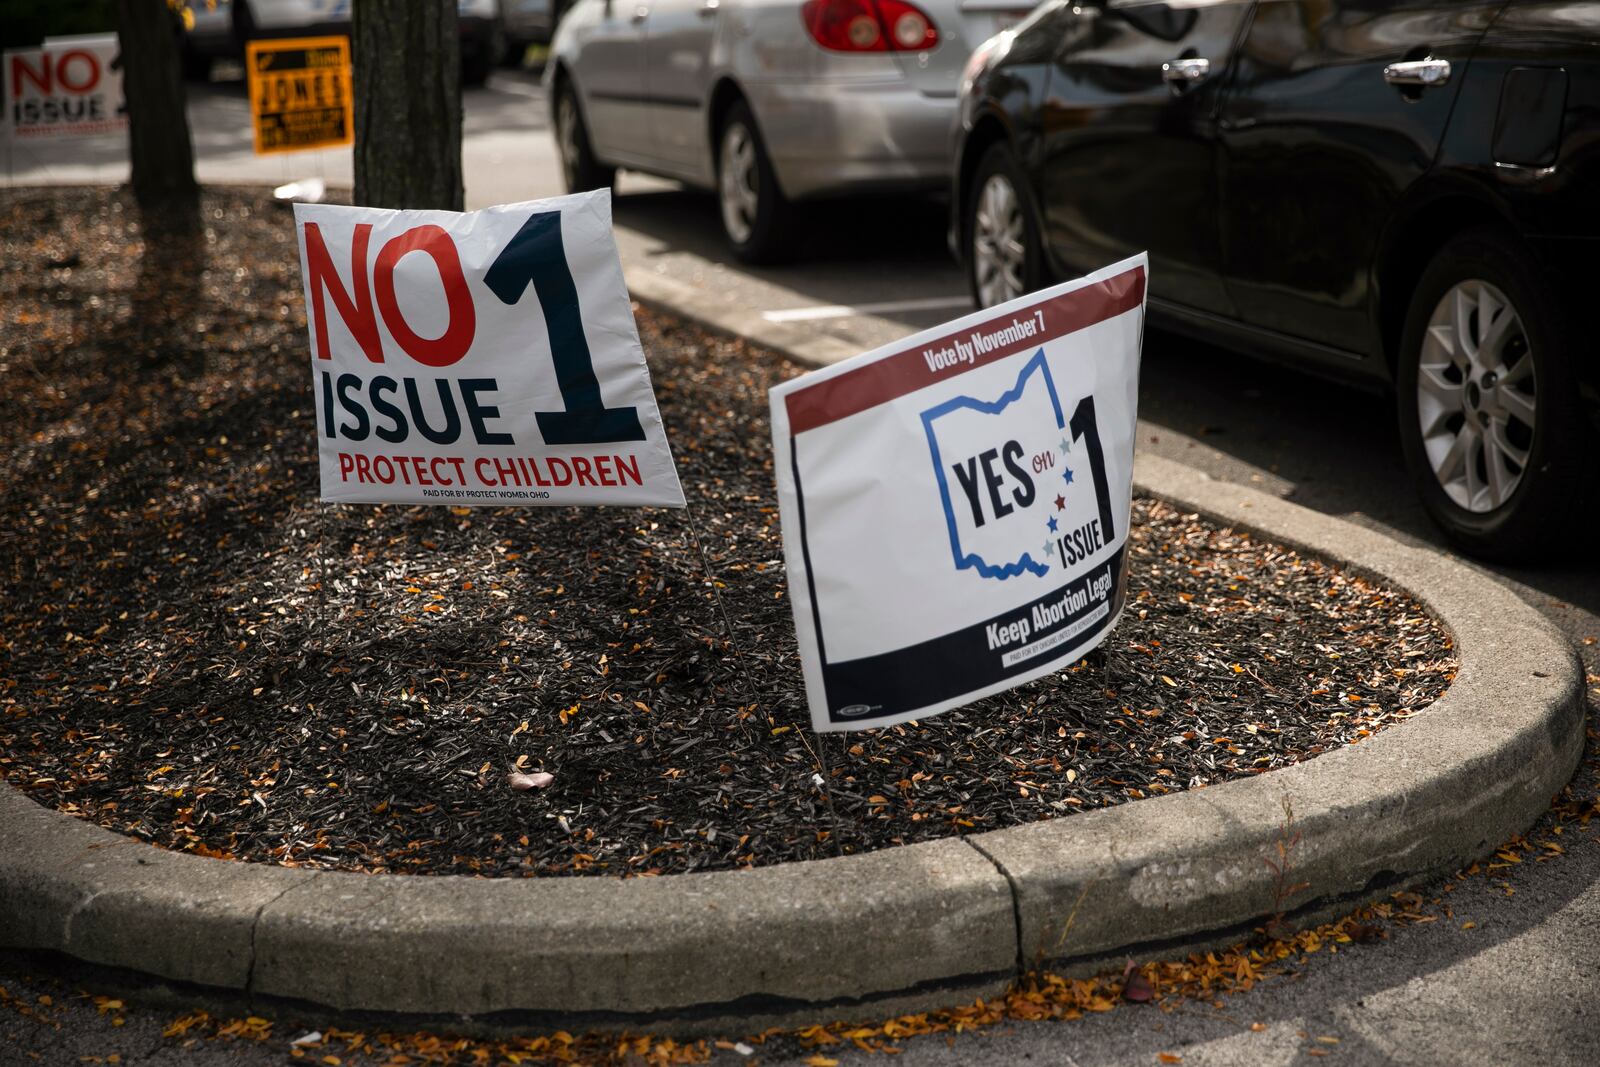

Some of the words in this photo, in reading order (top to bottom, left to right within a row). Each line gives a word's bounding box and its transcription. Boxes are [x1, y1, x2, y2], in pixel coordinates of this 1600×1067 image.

[11, 49, 101, 97] NO
[14, 95, 103, 125] ISSUE
[304, 222, 476, 367] NO
[483, 210, 647, 445] 1
[923, 349, 958, 373] Vote
[954, 340, 975, 364] by
[971, 318, 1037, 355] November
[1034, 309, 1046, 332] 7
[322, 371, 516, 445] ISSUE
[338, 452, 467, 487] PROTECT
[474, 454, 644, 487] CHILDREN
[423, 489, 440, 497] PAID
[440, 490, 455, 498] FOR
[456, 490, 465, 498] BY
[466, 490, 498, 498] PROTECT
[499, 491, 529, 499] WOMEN
[529, 491, 550, 499] OHIO
[952, 440, 1036, 528] YES
[1032, 451, 1055, 474] on
[1069, 395, 1115, 546] 1
[1057, 519, 1102, 569] ISSUE
[985, 617, 1031, 651] Keep
[1031, 589, 1088, 632] Abortion
[1086, 564, 1112, 601] Legal
